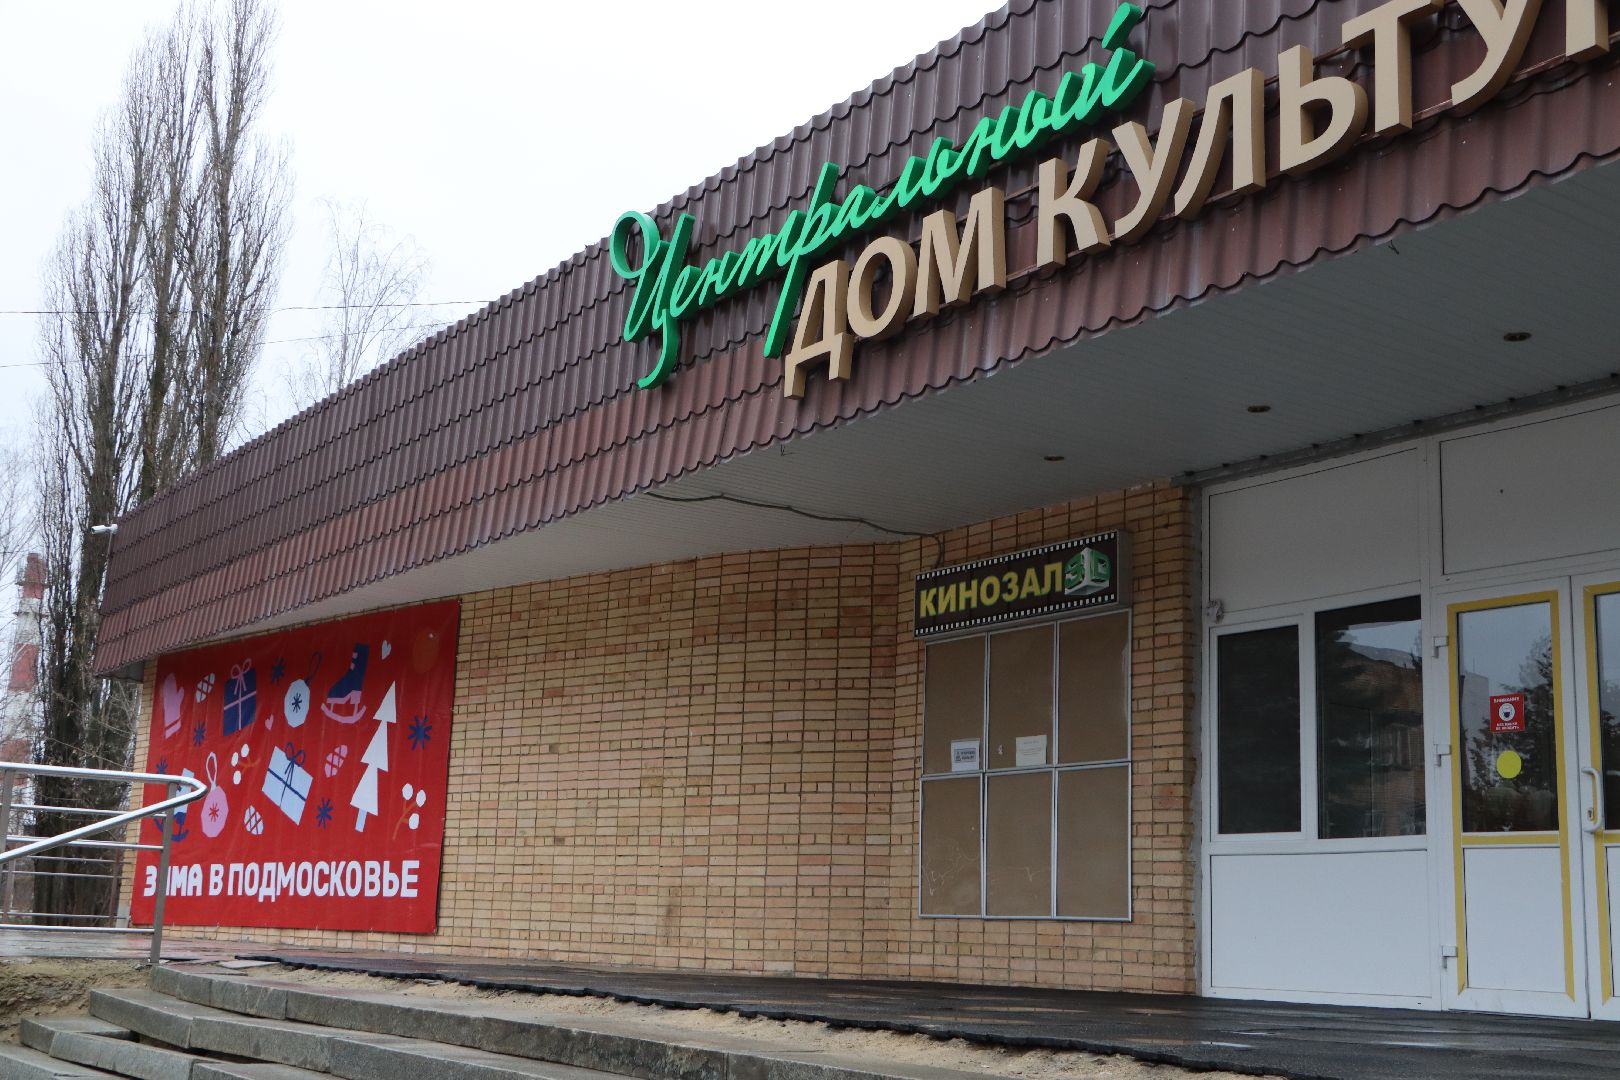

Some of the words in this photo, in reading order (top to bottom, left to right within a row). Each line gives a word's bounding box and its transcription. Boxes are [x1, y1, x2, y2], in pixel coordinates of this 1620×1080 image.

[608, 2, 1156, 388] Центральный
[784, 186, 1006, 399] ДОМ
[919, 561, 1063, 618] КИНОЗАЛ
[1064, 548, 1111, 595] 3D
[208, 863, 224, 896] В
[227, 860, 420, 902] ПОДМОСКОВЬЕ
